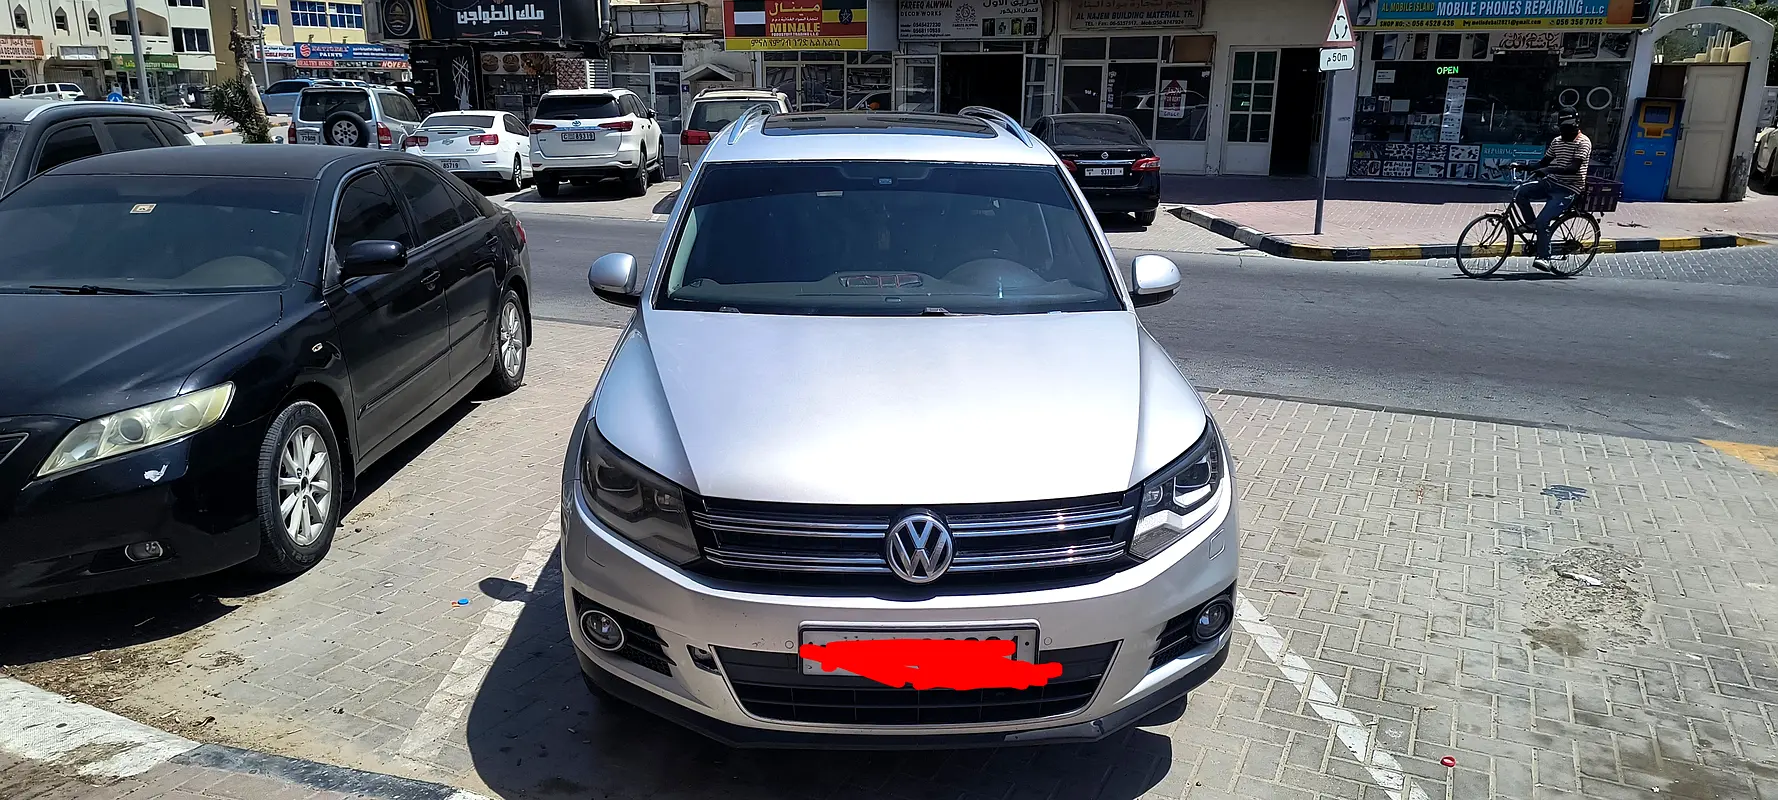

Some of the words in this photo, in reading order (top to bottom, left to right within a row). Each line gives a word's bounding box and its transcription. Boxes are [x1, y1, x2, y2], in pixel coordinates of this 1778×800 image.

[515, 4, 545, 20] ملك
[1389, 2, 1413, 12] MOBILE
[1414, 2, 1435, 11] ISLAND
[1437, 1, 1477, 16] MOBILE
[1479, 1, 1521, 15] PHONES
[1524, 0, 1583, 14] REPAIRING
[1076, 12, 1084, 20] AL
[1086, 12, 1110, 20] NAJEM
[1111, 11, 1144, 20] BUILDING
[1146, 10, 1180, 19] MATERIAL
[1556, 18, 1569, 26] 056
[769, 22, 821, 33] MINALE
[1436, 66, 1459, 75] OPEN
